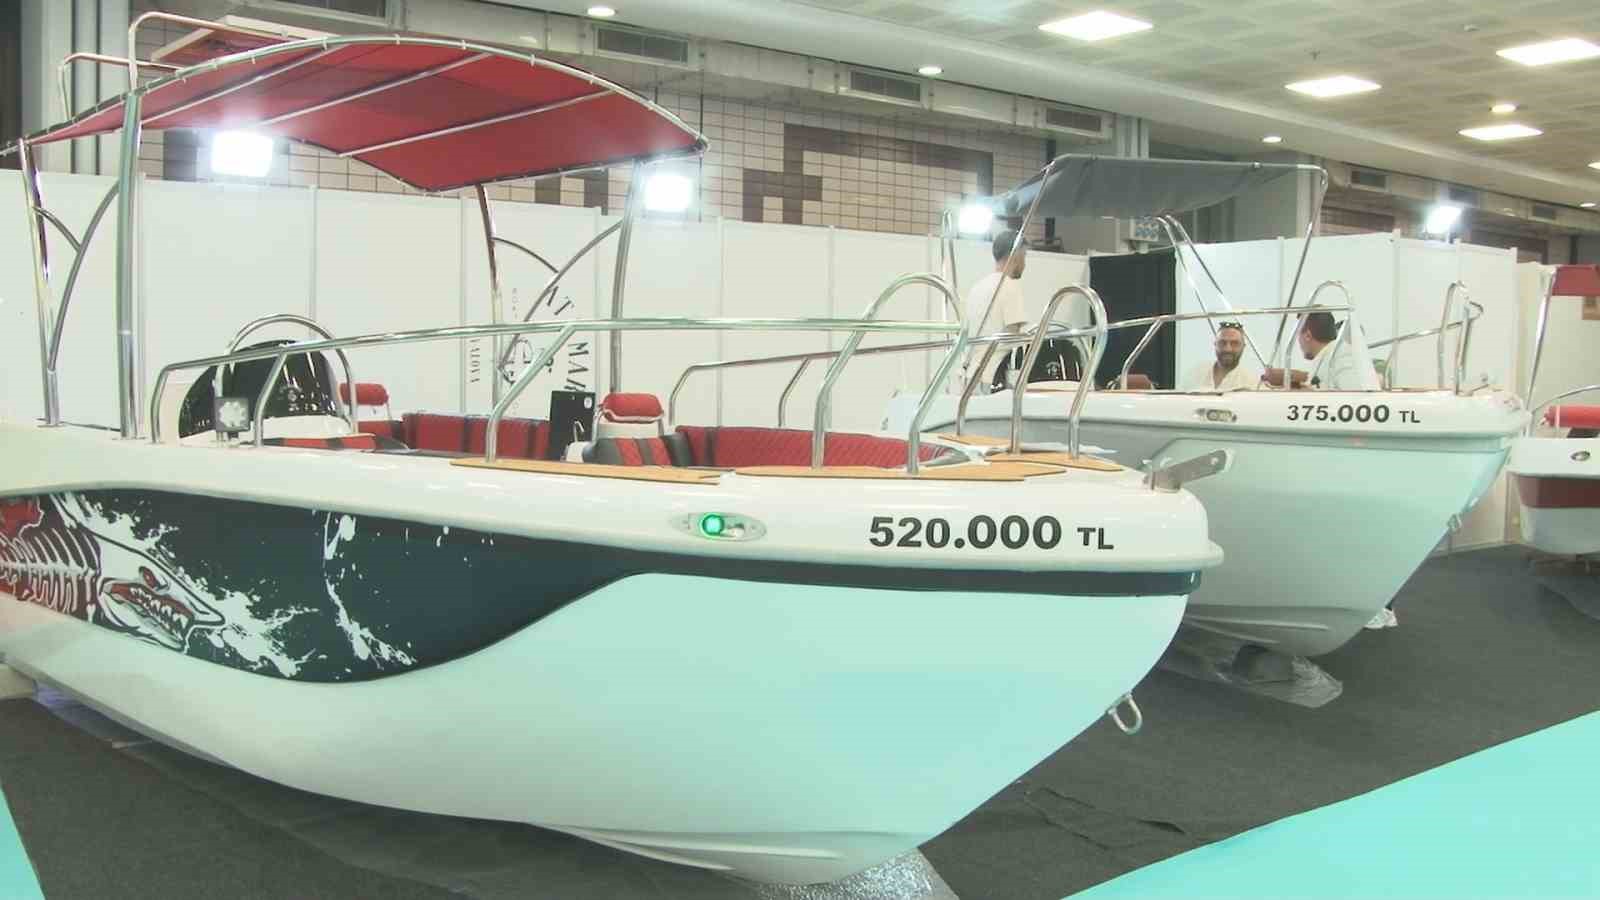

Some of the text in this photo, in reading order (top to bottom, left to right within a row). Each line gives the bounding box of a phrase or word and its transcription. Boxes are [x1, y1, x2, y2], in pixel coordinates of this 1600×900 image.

[1286, 404, 1421, 424] 375.000 TL
[869, 514, 1114, 550] 520.000 TL
